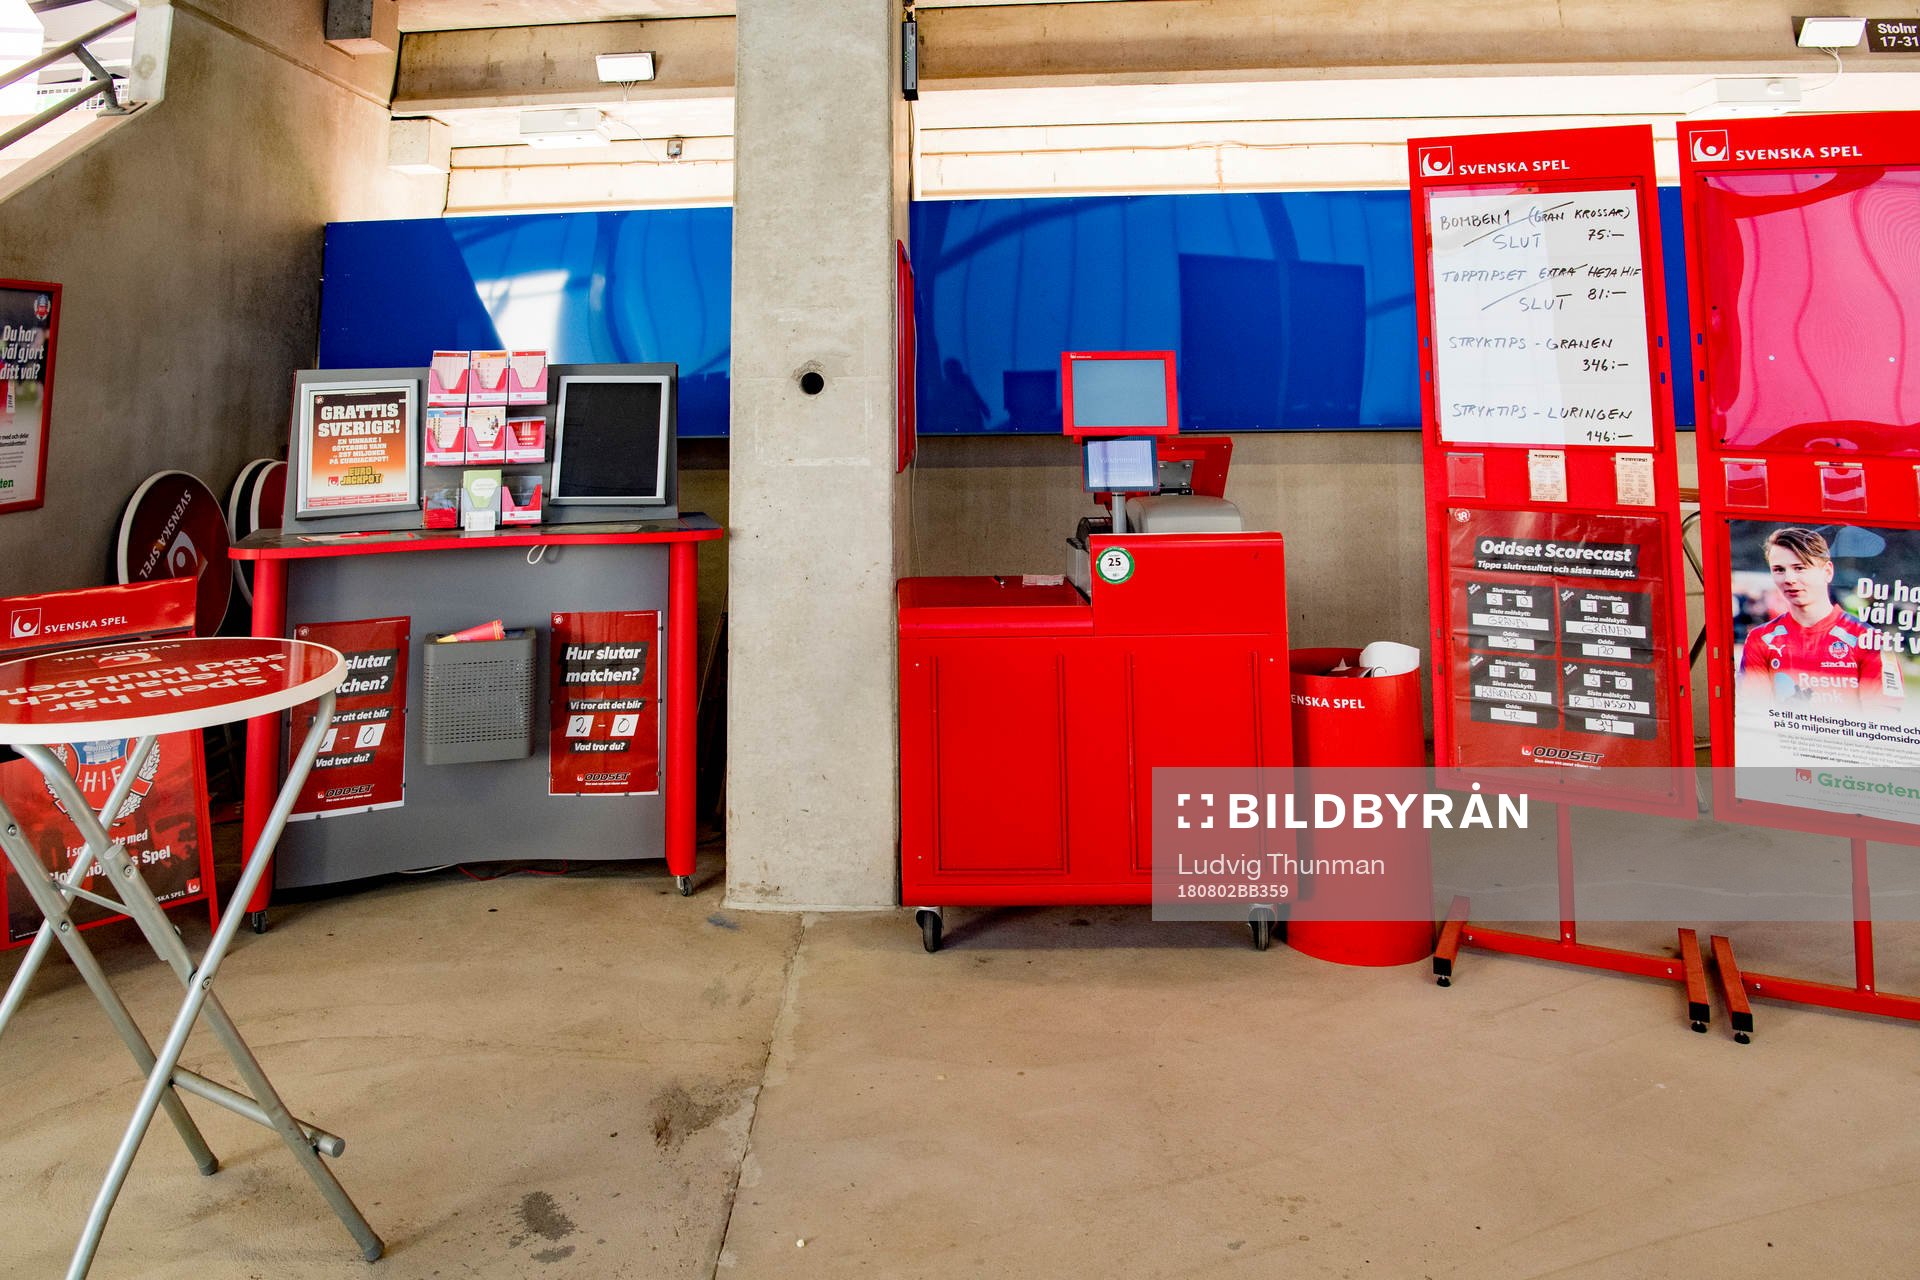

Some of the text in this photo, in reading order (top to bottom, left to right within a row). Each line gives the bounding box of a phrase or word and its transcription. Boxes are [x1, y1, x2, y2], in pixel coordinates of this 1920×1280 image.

[1877, 22, 1917, 34] Stolnr
[1880, 35, 1920, 47] 17-31
[1736, 145, 1863, 161] SVENSKA SPEL
[1459, 159, 1570, 175] SVENSKA SPEL
[1493, 233, 1541, 249] SLUT
[1442, 269, 1527, 283] TOPPTIPSET
[1539, 267, 1577, 280] EXTRA
[1519, 293, 1572, 312] SLUT
[3, 325, 36, 342] Du har
[1449, 336, 1613, 349] STRYKTIPS GRANEN
[2, 343, 44, 363] väl gjort
[0, 363, 40, 379] ditt val?
[321, 403, 399, 420] GRATTIS
[1452, 403, 1633, 420] STRYKTIPS LURINGEN
[318, 420, 400, 437] SVERIGE!
[348, 466, 373, 476] EURO
[157, 489, 192, 547] SVENSKA
[1480, 539, 1632, 562] Oddset Scorecast
[139, 545, 161, 579] SPEL
[1108, 557, 1121, 567] 25
[1477, 560, 1636, 578] Tippa slutresultat och sista målskytt.
[1857, 577, 1920, 603] Du ha
[44, 615, 128, 633] SVENSKA SPEL
[1858, 602, 1920, 632] väl gj
[1858, 627, 1904, 653] ditt
[346, 653, 391, 670] slutar
[566, 646, 641, 660] Hur slutar
[1820, 660, 1858, 668] stadium
[0, 653, 287, 696] stöd klubben
[105, 666, 260, 692] arenan
[566, 667, 640, 683] matchen?
[1798, 672, 1859, 689] Resurs
[335, 675, 389, 694] tchen?
[8, 689, 95, 706] och
[48, 675, 267, 712] Spela här
[1290, 694, 1365, 709] ENSKA SPEL
[570, 700, 643, 710] Vi tror att det blir
[342, 708, 389, 721] att det blir
[1769, 709, 1920, 735] Se till att Helsingborg är med och
[575, 716, 630, 734] 2 0
[1774, 719, 1785, 728] på
[1788, 721, 1800, 730] 50
[1801, 722, 1840, 734] miljoner
[1842, 728, 1854, 737] till
[1855, 731, 1920, 745] ungdomsidro
[574, 742, 626, 751] Vad tror du?
[1533, 745, 1605, 763] ODDSET
[316, 752, 370, 767] Vad tror du?
[584, 772, 631, 781] ODDSET
[325, 784, 374, 798] ODDSET
[1817, 772, 1920, 799] Gräsroten
[127, 829, 148, 844] med
[142, 845, 171, 864] Spel
